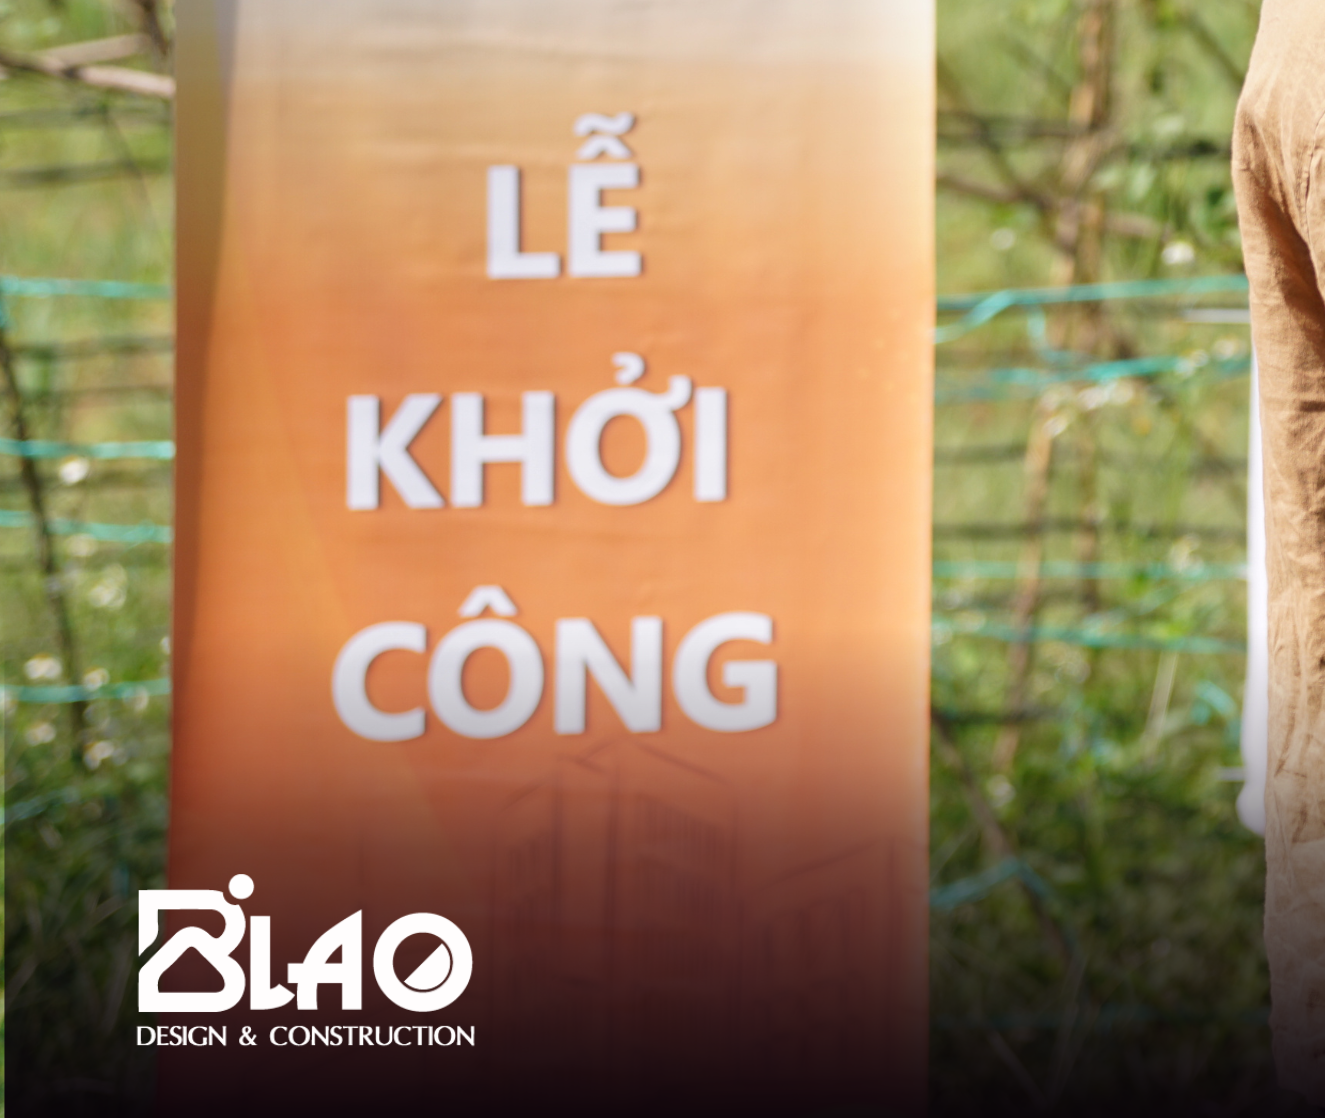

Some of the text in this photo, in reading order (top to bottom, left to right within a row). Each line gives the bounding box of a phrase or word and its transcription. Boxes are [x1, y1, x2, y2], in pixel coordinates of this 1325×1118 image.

[486, 112, 643, 279] LỄ
[346, 352, 728, 511] KHỞI
[331, 584, 779, 742] CÔNG
